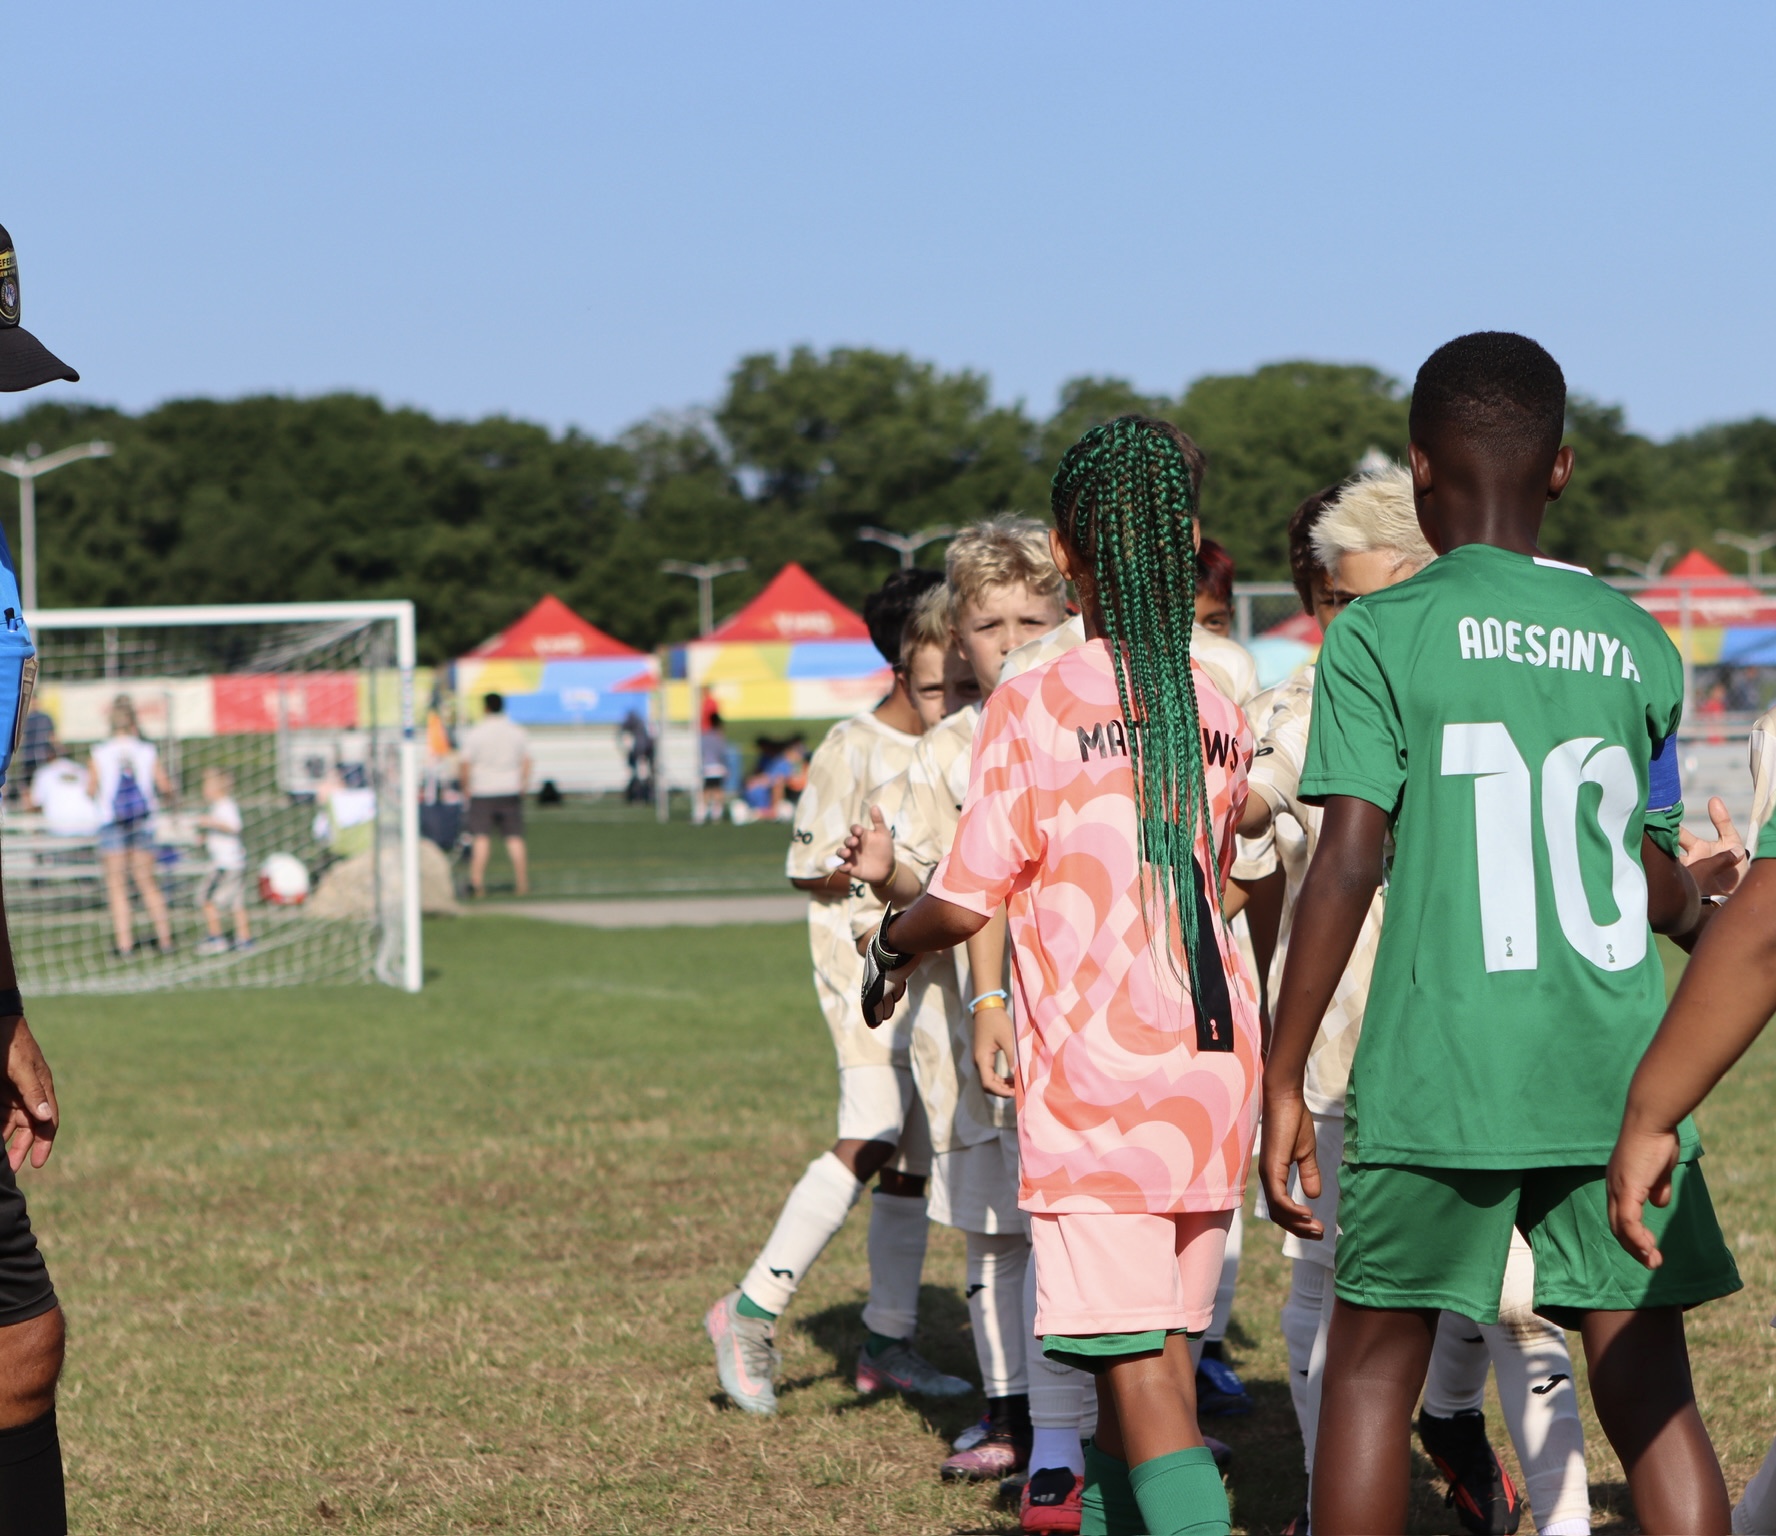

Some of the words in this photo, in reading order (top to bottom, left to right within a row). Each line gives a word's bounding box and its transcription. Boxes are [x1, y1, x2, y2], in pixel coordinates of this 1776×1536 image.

[1458, 616, 1641, 683] ADESANYA
[1076, 719, 1239, 773] MATWS
[1440, 722, 1648, 973] 10
